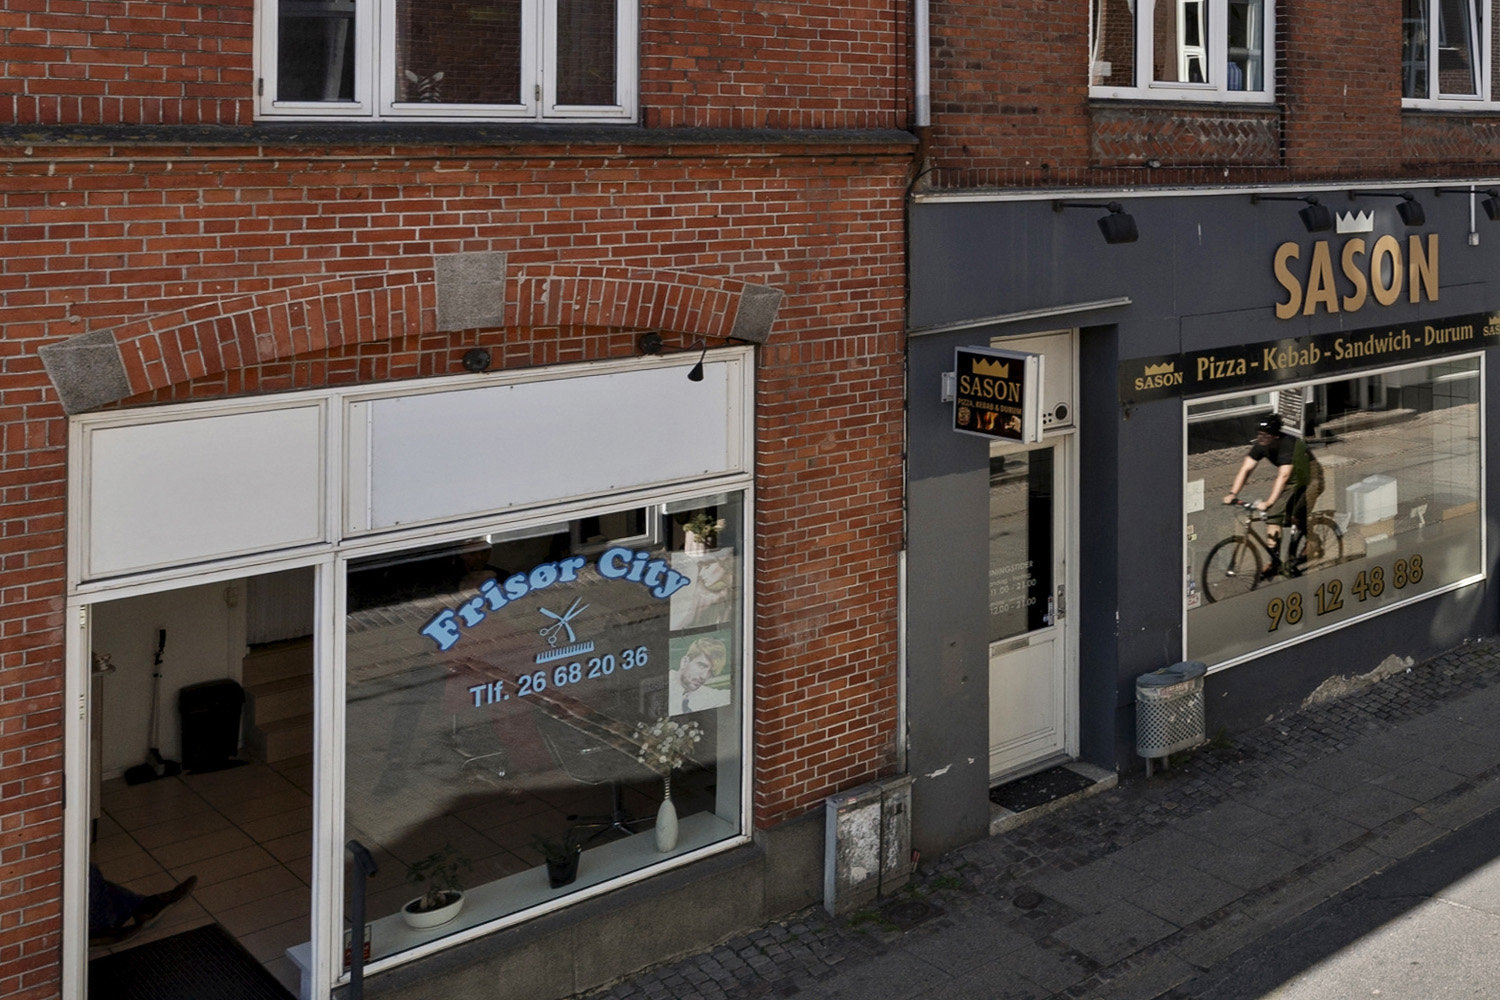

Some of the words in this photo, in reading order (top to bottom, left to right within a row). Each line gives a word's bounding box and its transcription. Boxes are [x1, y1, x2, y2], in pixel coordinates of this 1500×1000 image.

[1274, 234, 1439, 319] SASON
[1135, 371, 1184, 391] SASON
[1197, 356, 1247, 381] Pizza
[1263, 343, 1321, 371] Kebab
[1334, 329, 1411, 360] Sandwich
[1424, 324, 1474, 346] Durum
[960, 375, 1021, 403] SASON
[420, 554, 587, 650] Frisør
[597, 546, 691, 600] City
[1267, 591, 1303, 632] 98
[1314, 579, 1344, 616] 12
[1352, 566, 1385, 602] 48
[1393, 554, 1424, 589] 88
[469, 680, 510, 707] Tlf.
[517, 671, 547, 698] 26
[553, 662, 582, 688] 68
[587, 654, 616, 679] 20
[621, 646, 649, 671] 36
